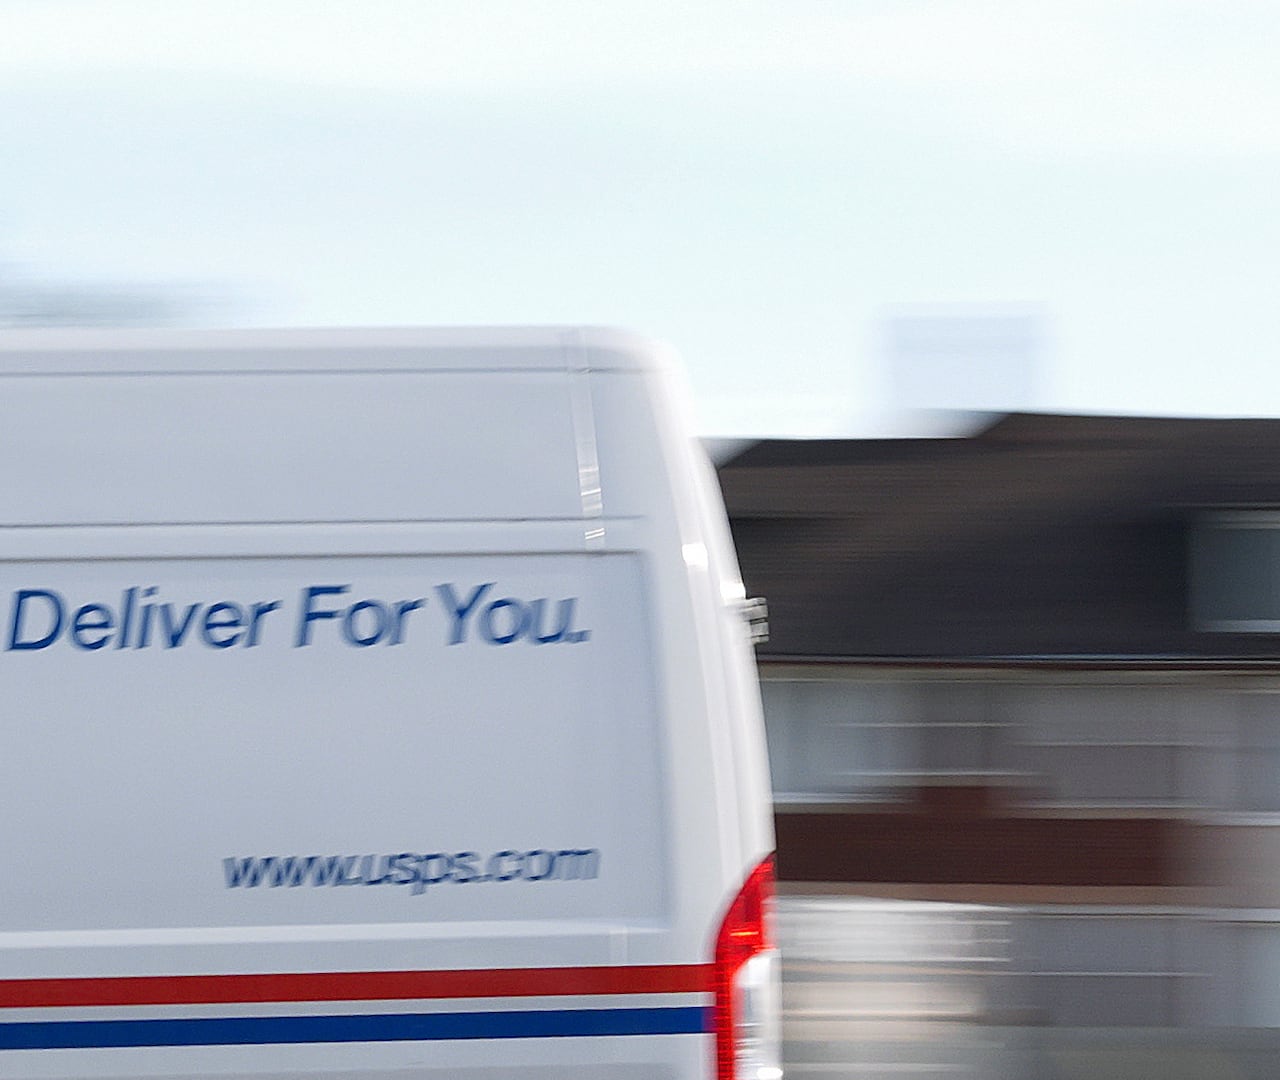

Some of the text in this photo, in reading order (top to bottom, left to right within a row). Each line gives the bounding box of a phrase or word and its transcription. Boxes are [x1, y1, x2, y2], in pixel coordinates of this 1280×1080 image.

[5, 585, 283, 652] Deliver
[293, 583, 426, 648] For
[435, 582, 590, 646] You.
[223, 848, 599, 896] www.usps.com
